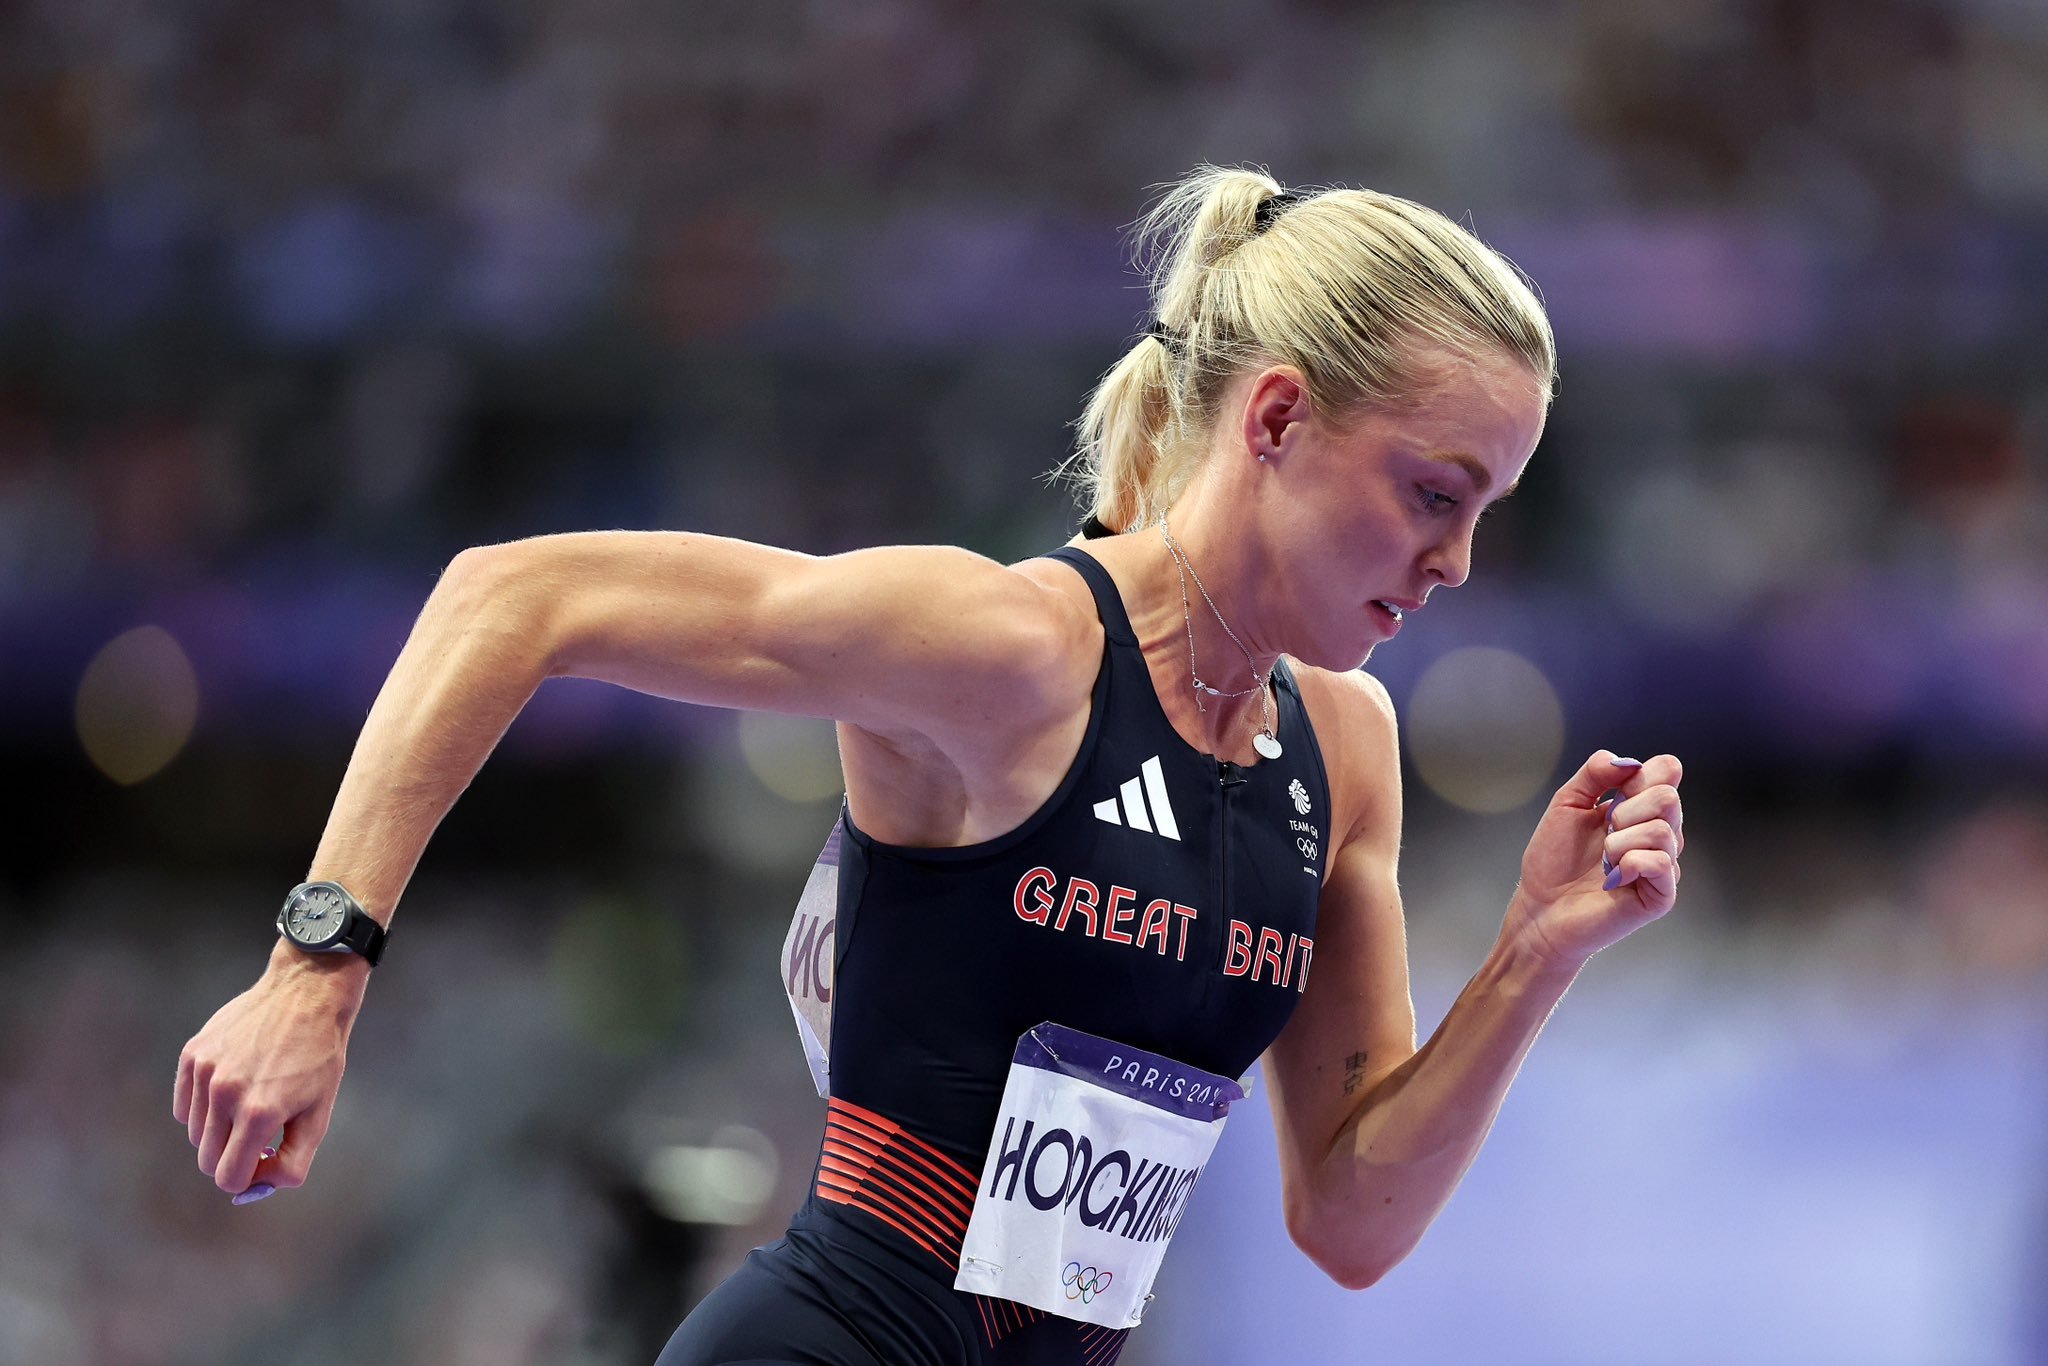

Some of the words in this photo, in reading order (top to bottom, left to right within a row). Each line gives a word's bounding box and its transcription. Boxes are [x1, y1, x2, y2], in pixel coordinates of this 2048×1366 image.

[1289, 820, 1309, 833] TEAM
[1013, 866, 1197, 961] GREAT
[1223, 919, 1314, 994] BRIT
[989, 1116, 1205, 1244] HODGKINSO
